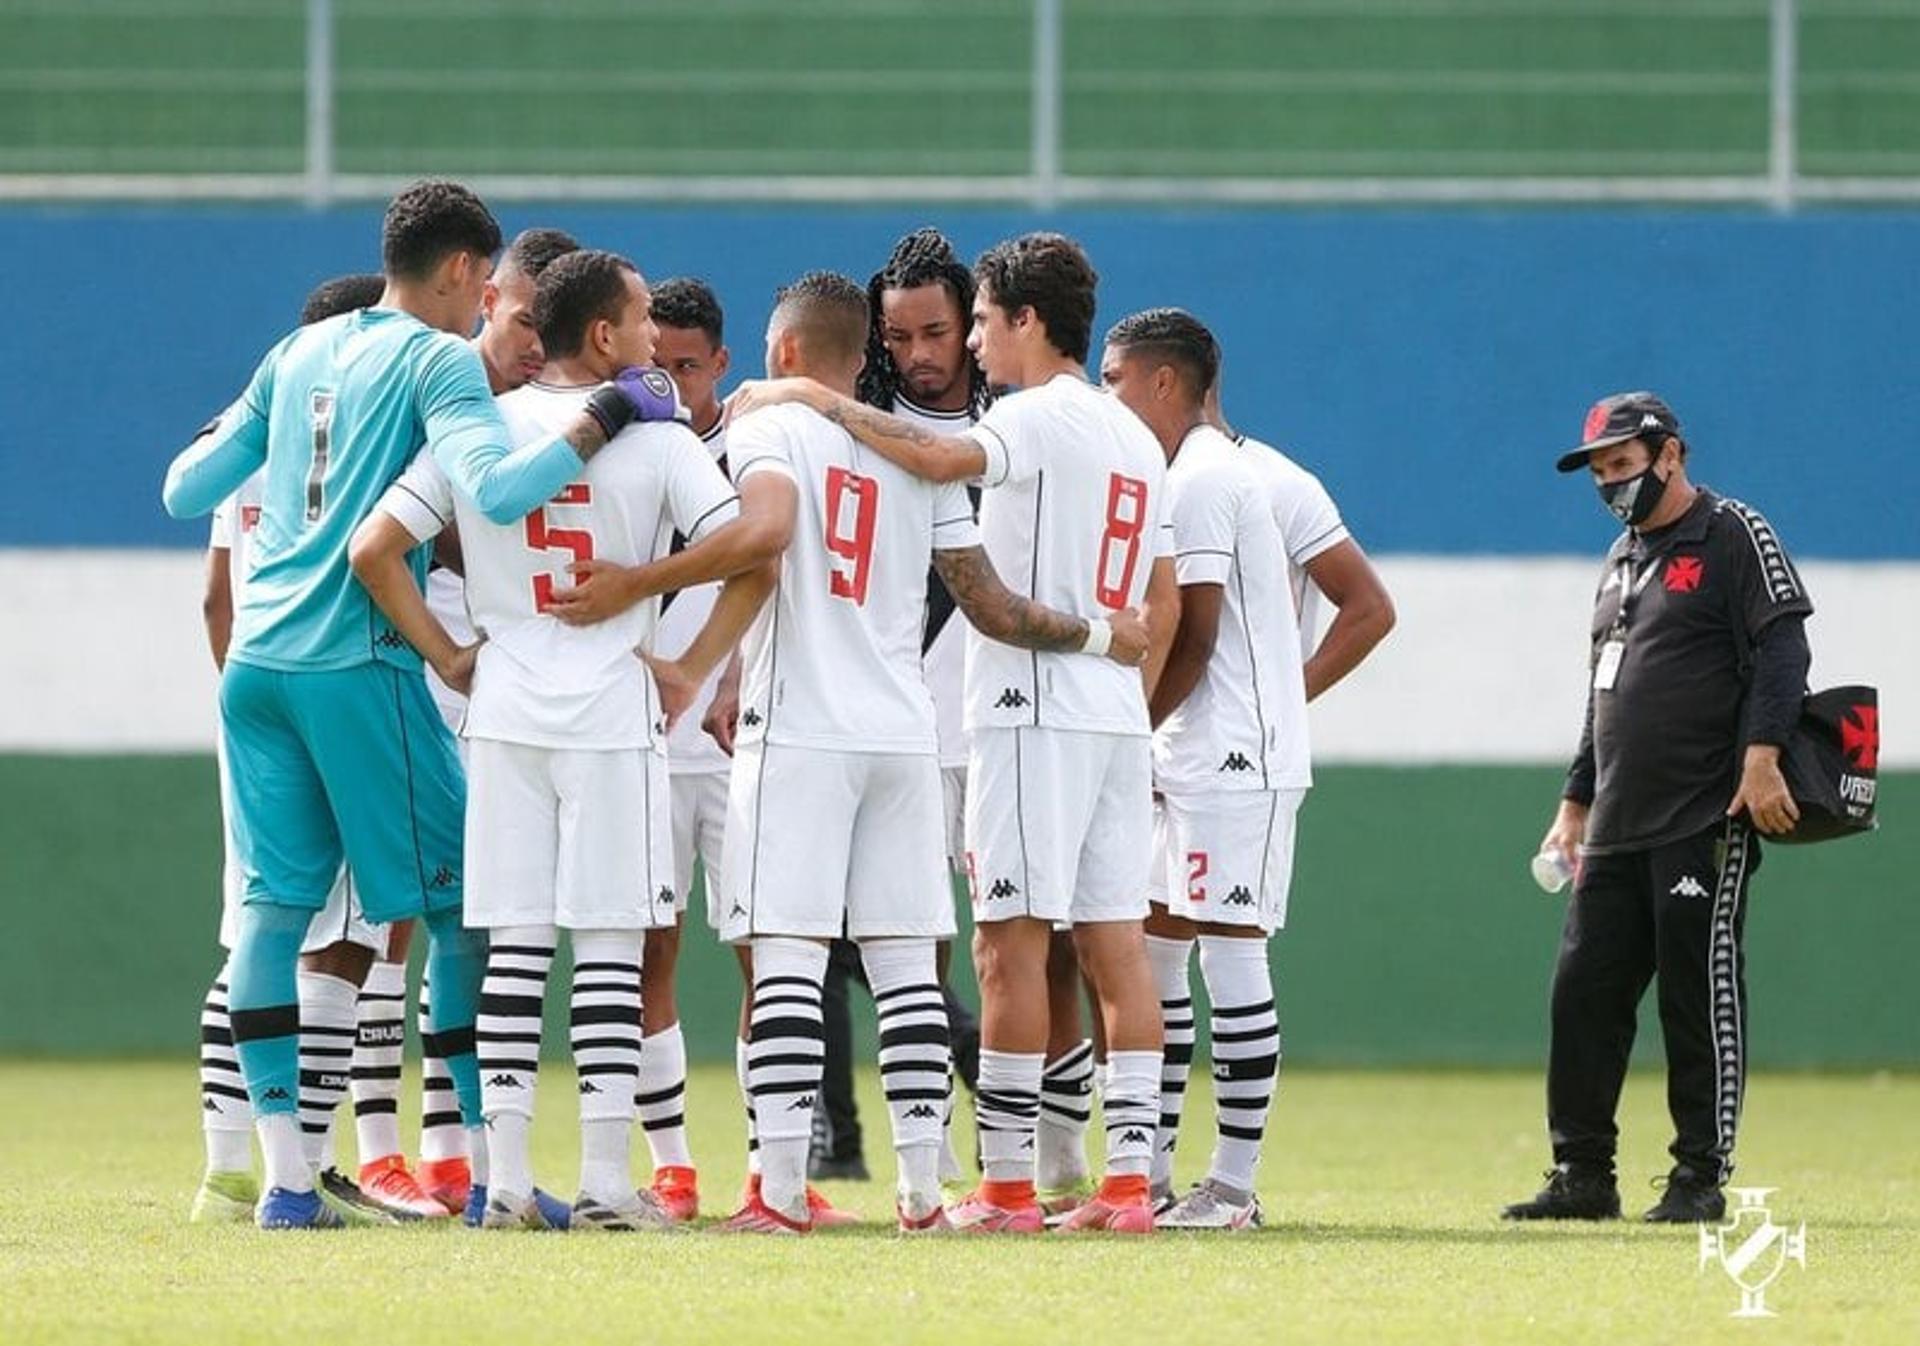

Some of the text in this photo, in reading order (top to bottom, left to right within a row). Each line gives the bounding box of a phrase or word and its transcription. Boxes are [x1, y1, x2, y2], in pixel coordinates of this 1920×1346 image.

[305, 390, 336, 523] 1
[524, 482, 595, 616] 5
[825, 464, 879, 608] 9
[1095, 470, 1148, 612] 8
[1187, 852, 1208, 902] 2
